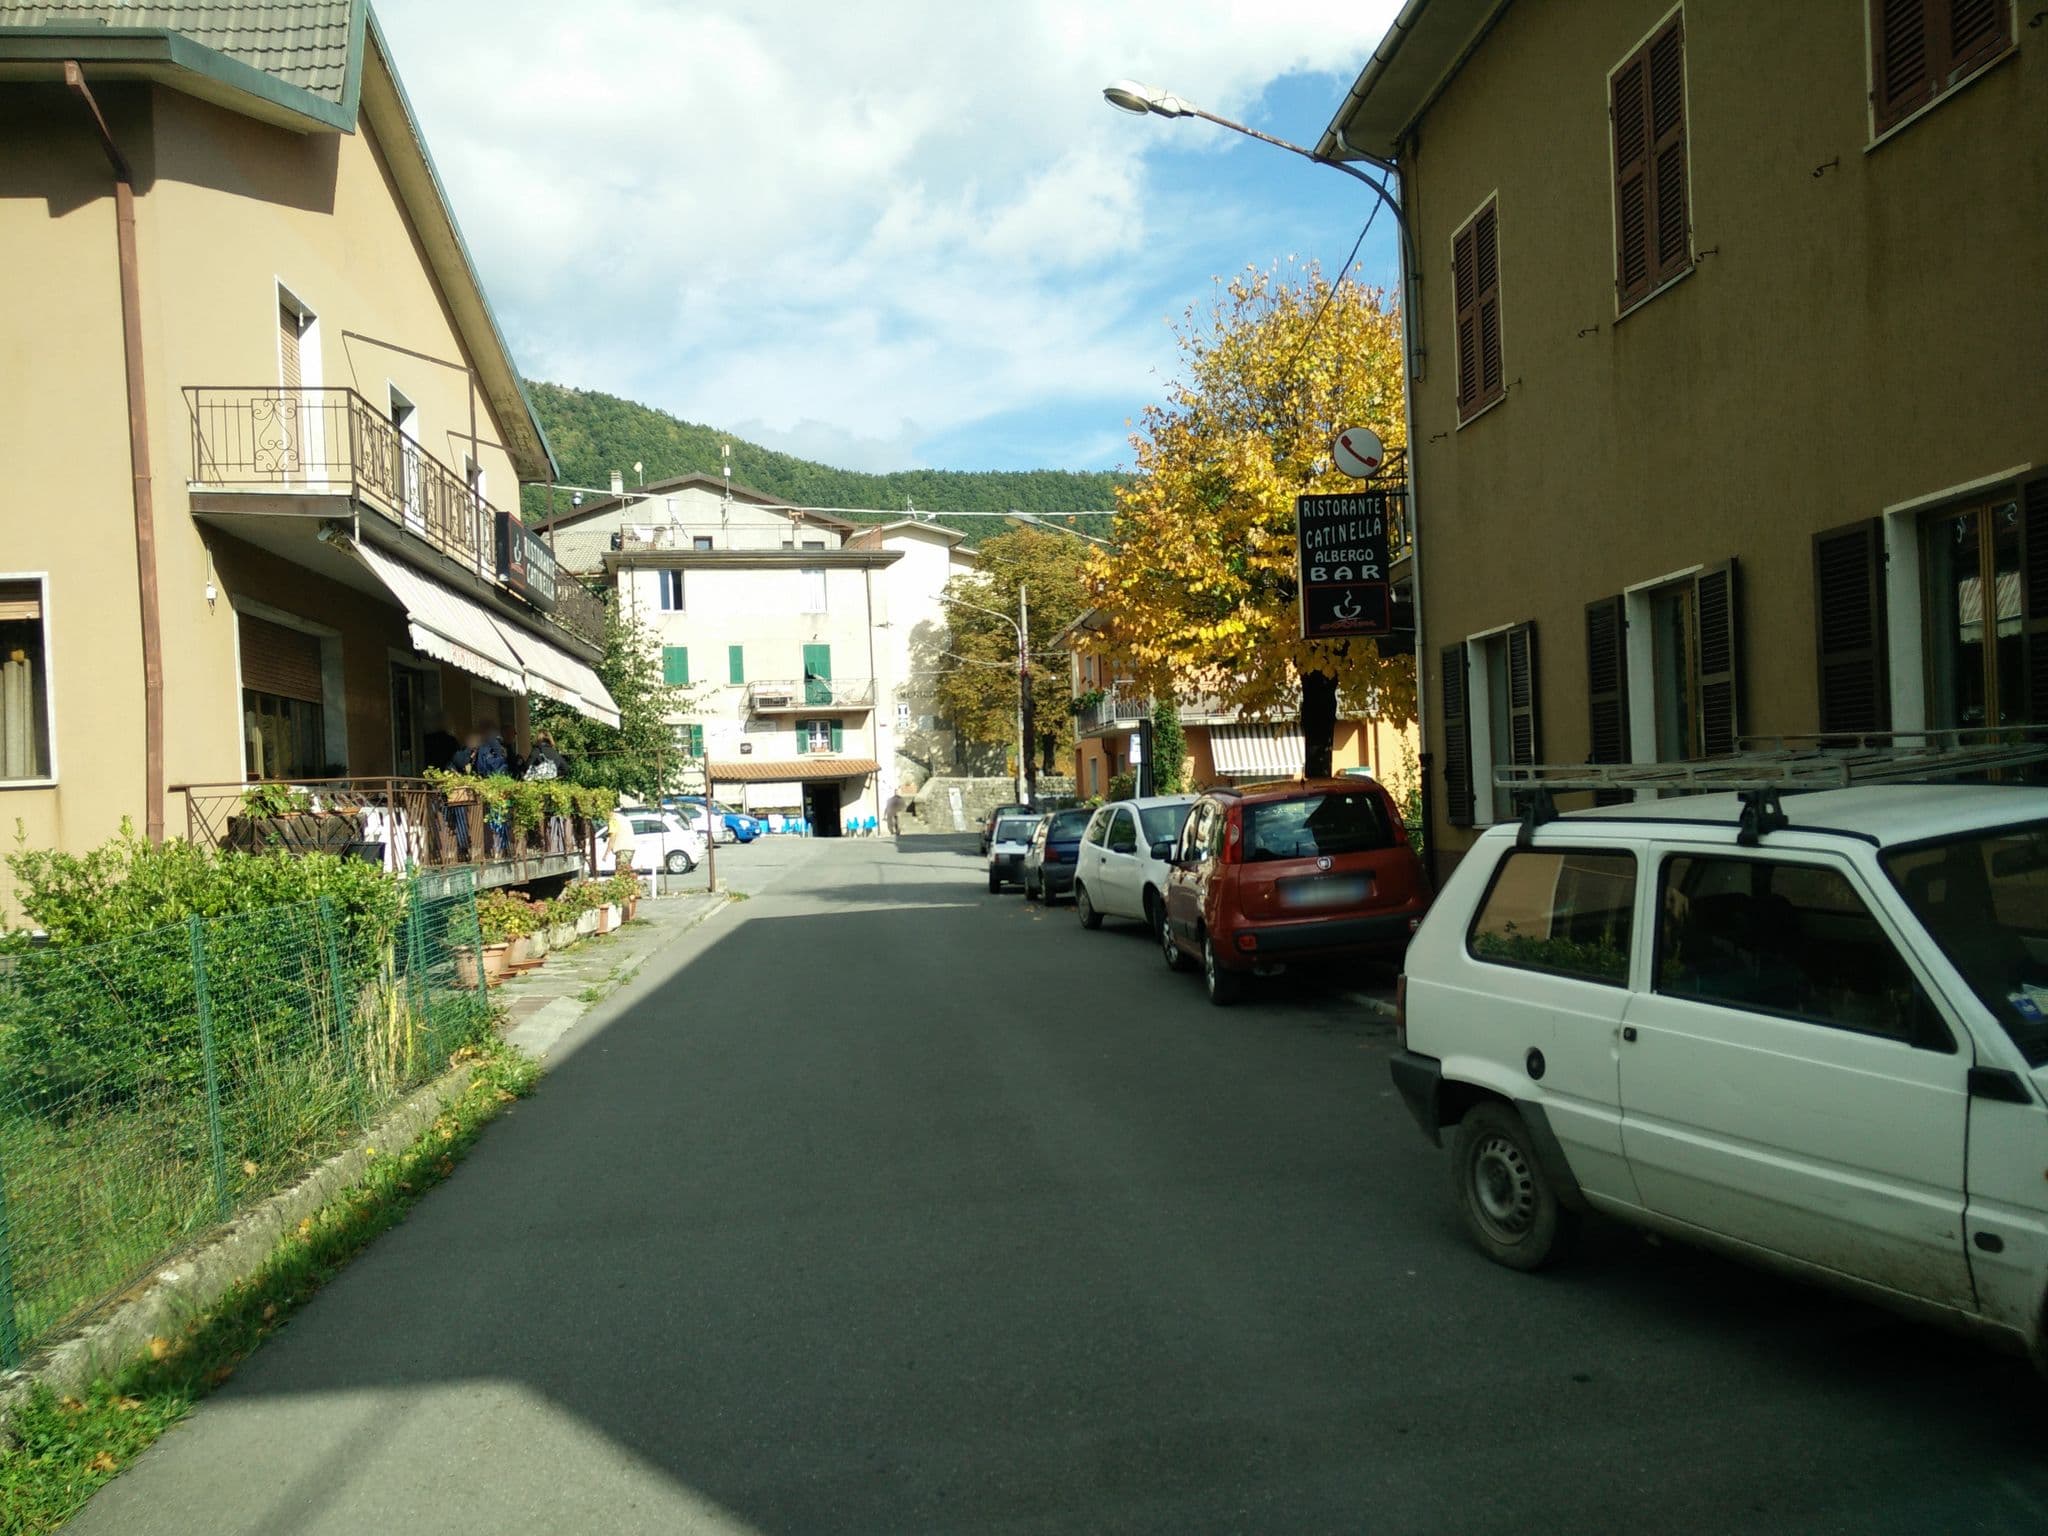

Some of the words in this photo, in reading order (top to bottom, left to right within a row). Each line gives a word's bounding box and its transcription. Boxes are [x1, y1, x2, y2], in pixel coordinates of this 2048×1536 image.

[1303, 498, 1380, 517] RISTORANTE
[1305, 517, 1382, 549] CATINELLA
[1315, 549, 1374, 563] ALBERGO
[1310, 564, 1380, 581] BAR
